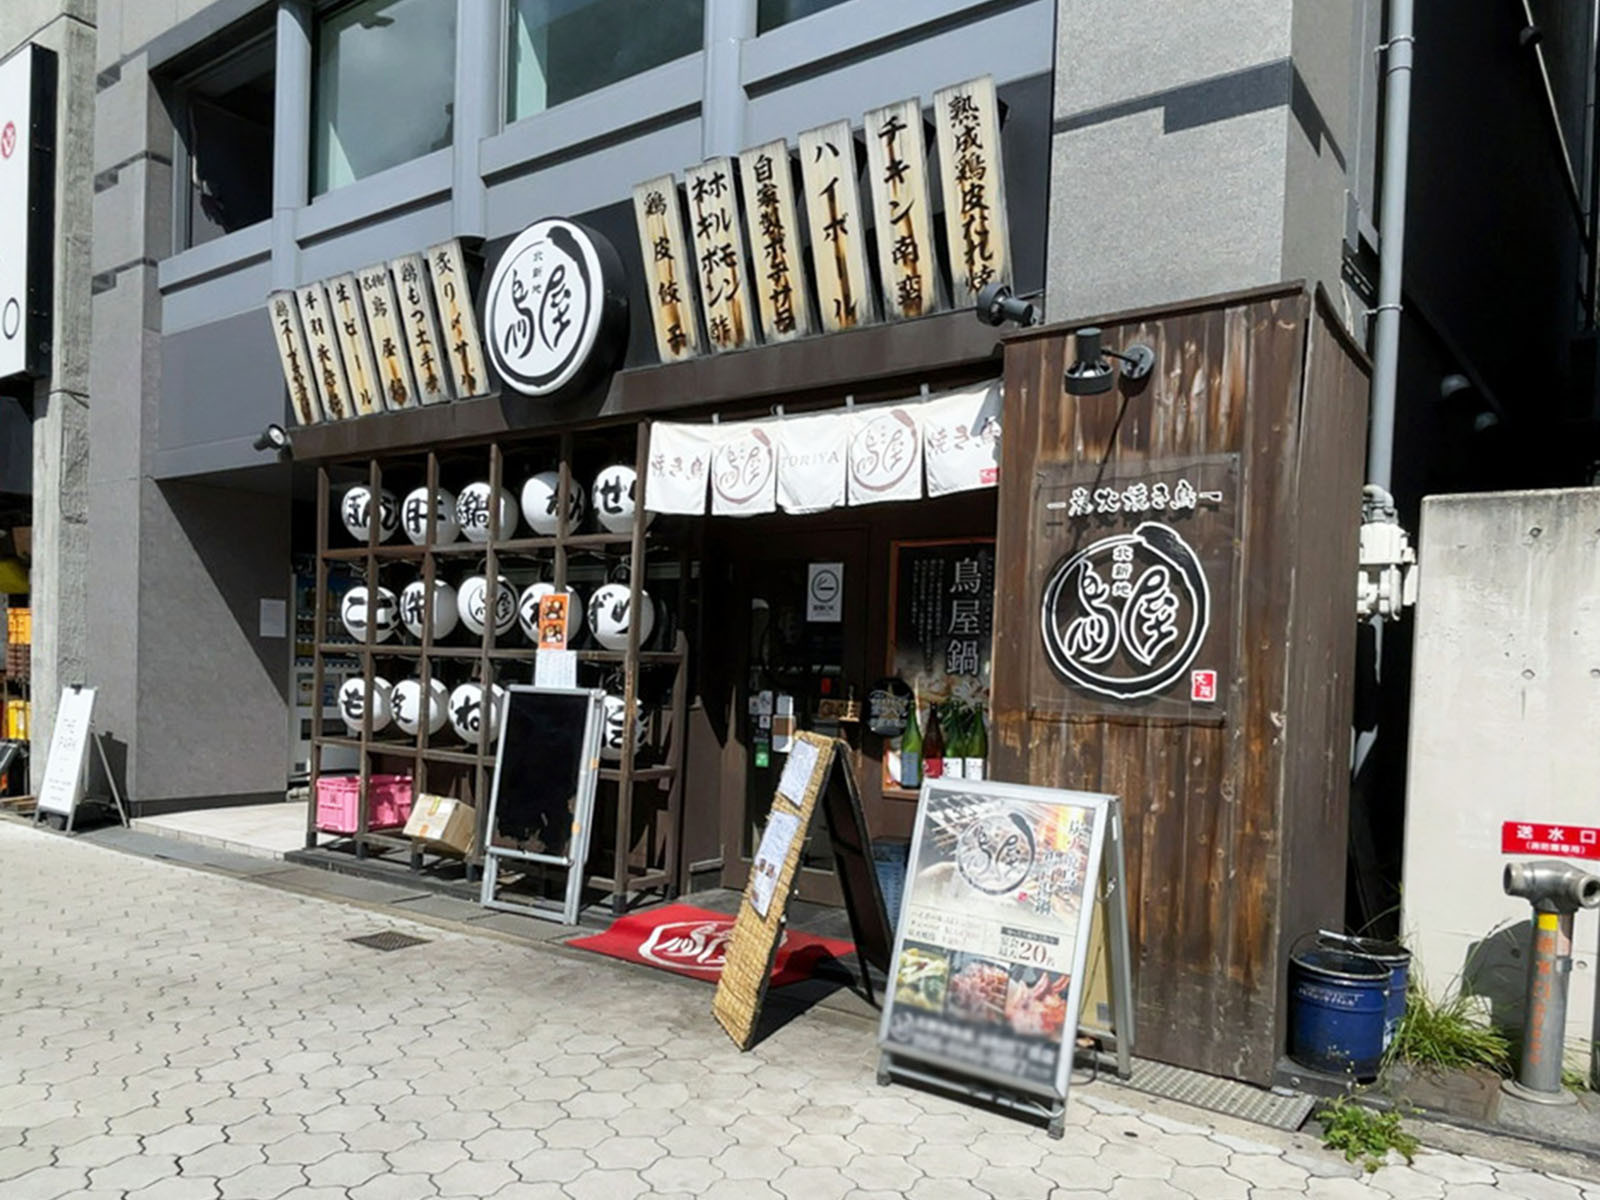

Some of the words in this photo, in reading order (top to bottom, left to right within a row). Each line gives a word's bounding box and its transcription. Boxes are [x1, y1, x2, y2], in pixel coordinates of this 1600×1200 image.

[644, 191, 688, 355] 鶏皮餃子
[709, 171, 741, 301] ホルモン
[753, 154, 796, 334] 自家製ポテサラ
[815, 142, 858, 321] ハイボール
[877, 115, 923, 307] チキン南蛮
[336, 283, 373, 405] 生ビール
[945, 556, 982, 676] 鳥屋鍋
[1516, 824, 1597, 845] 送水口
